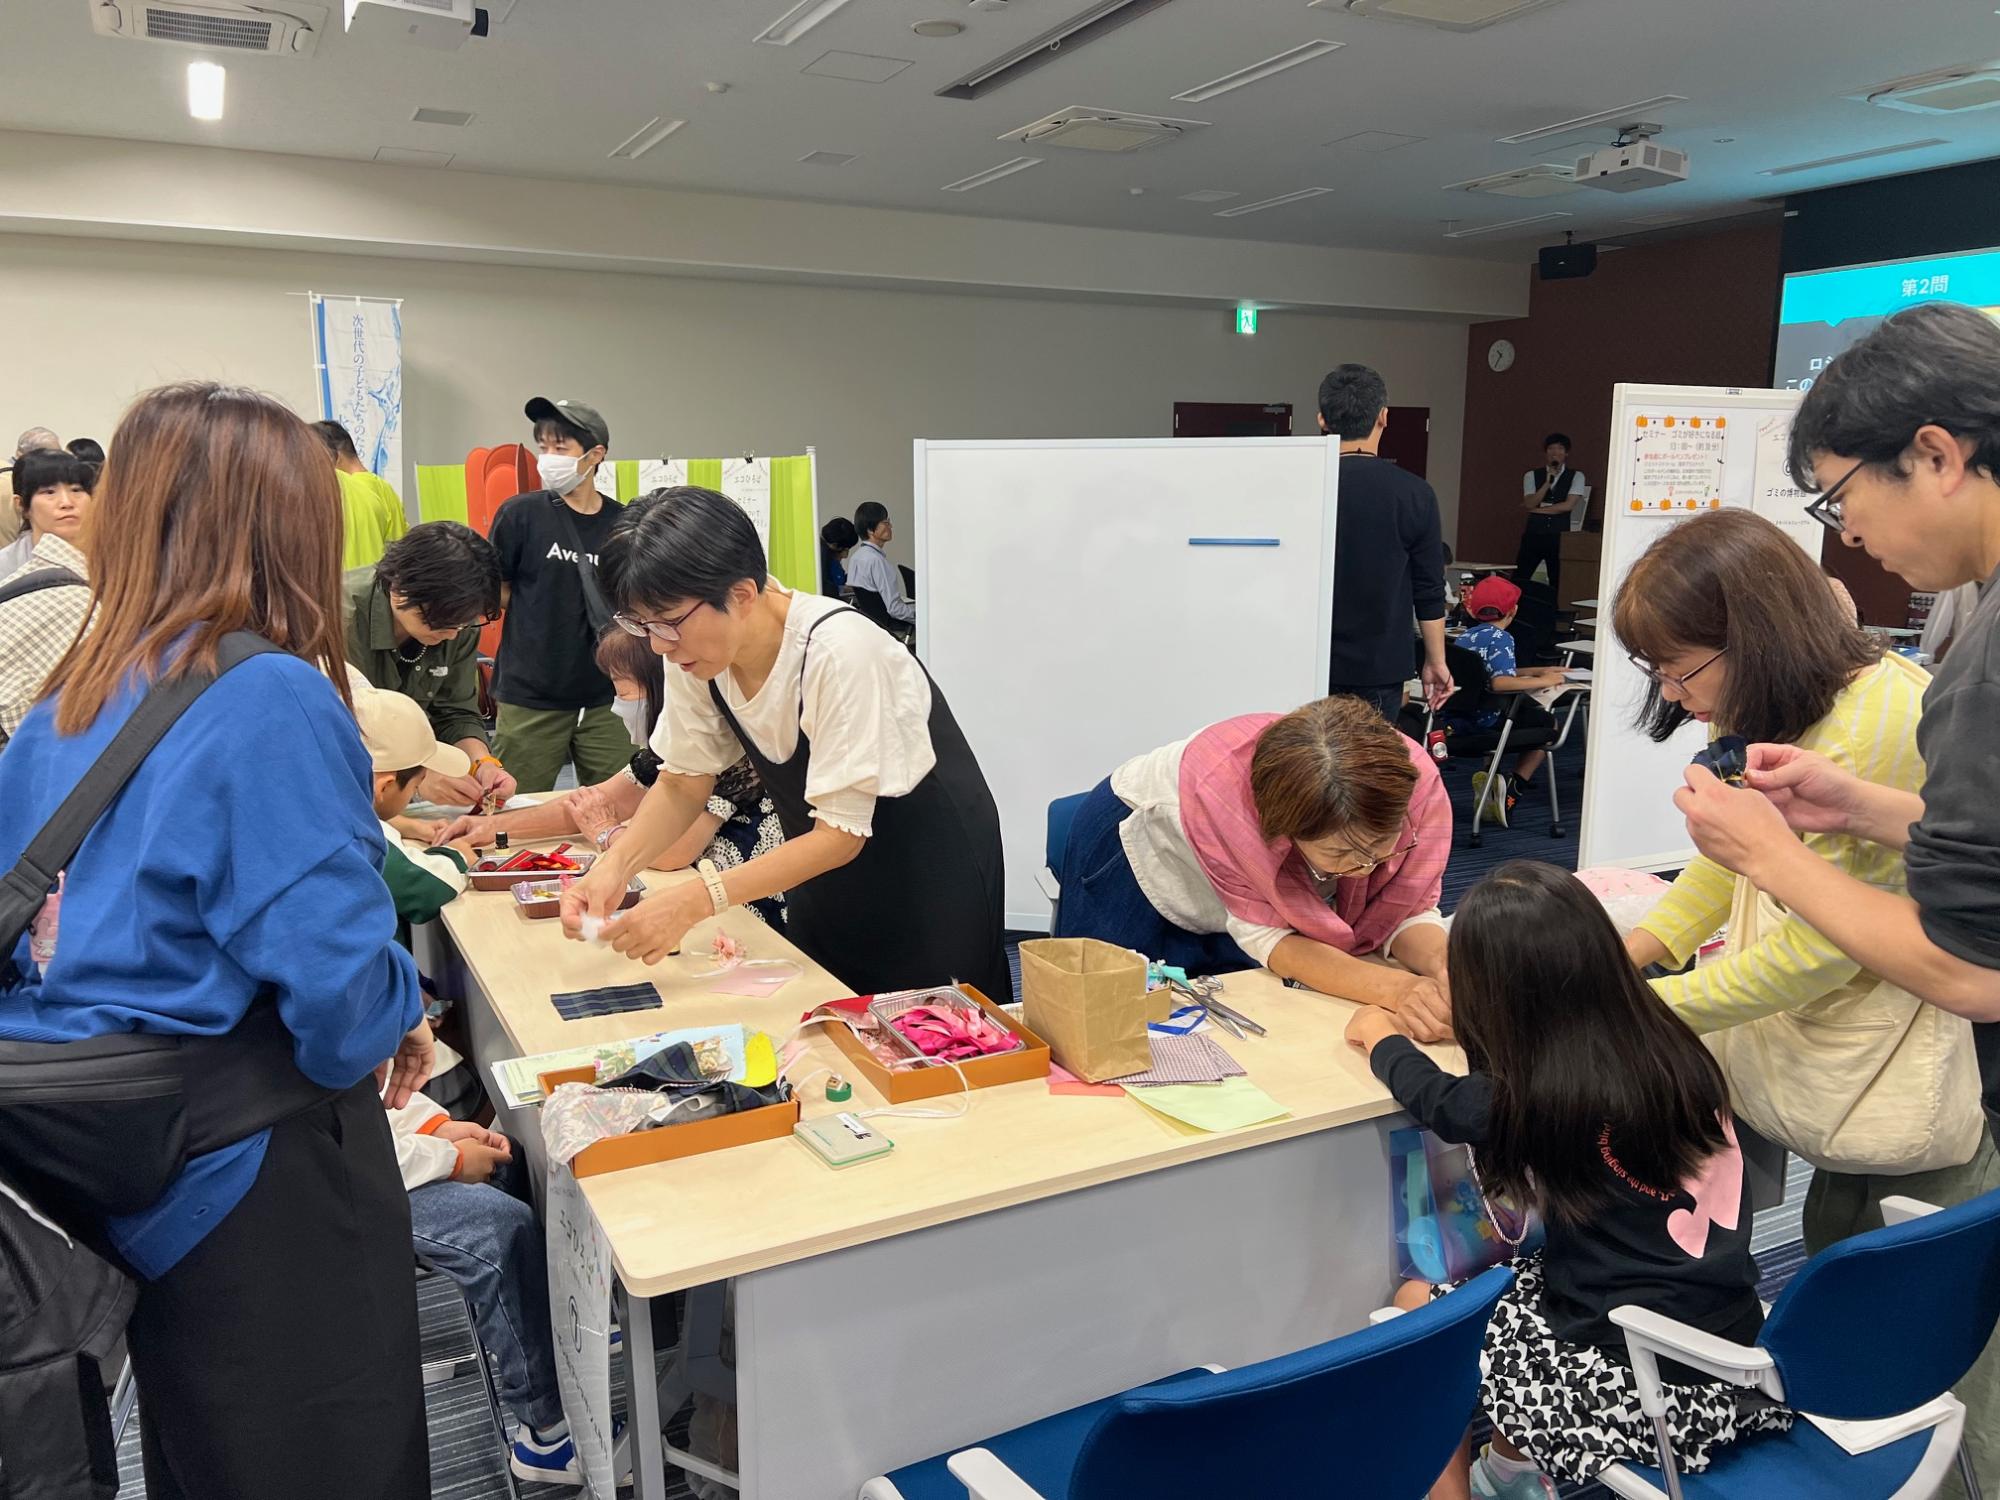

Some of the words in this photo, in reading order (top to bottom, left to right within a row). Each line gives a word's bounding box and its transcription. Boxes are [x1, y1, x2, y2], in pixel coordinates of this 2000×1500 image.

[1901, 275, 1949, 297] 第2問
[1642, 430, 1666, 439] セミナー
[1600, 1146, 1628, 1178] singing
[1639, 1184, 1657, 1198] and
